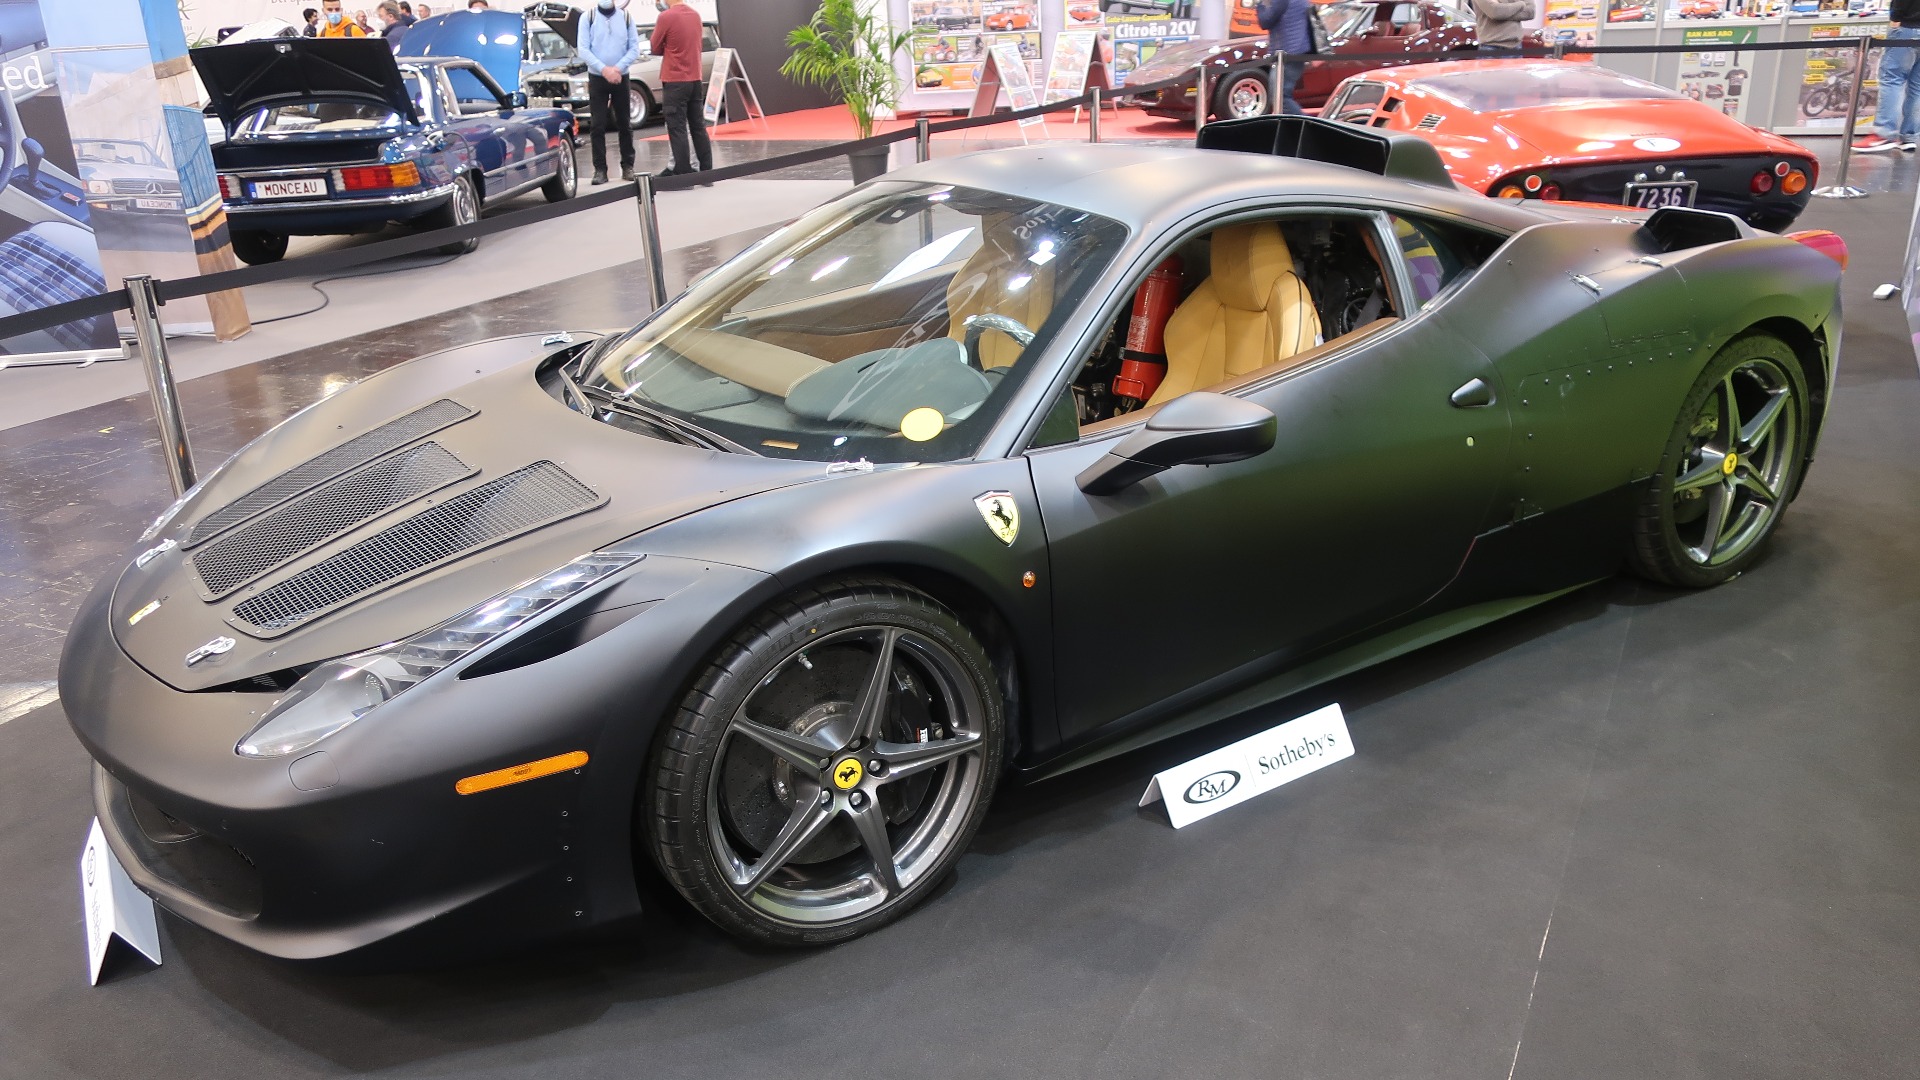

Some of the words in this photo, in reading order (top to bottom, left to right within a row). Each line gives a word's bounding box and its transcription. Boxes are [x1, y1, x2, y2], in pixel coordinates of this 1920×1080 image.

[1115, 22, 1167, 38] Citroën
[1169, 20, 1197, 35] 2CV
[1840, 25, 1888, 37] PREISE
[0, 56, 48, 91] ed
[264, 181, 318, 196] MONCEAU
[1636, 187, 1683, 208] 7236
[1258, 733, 1336, 775] Sotheby's
